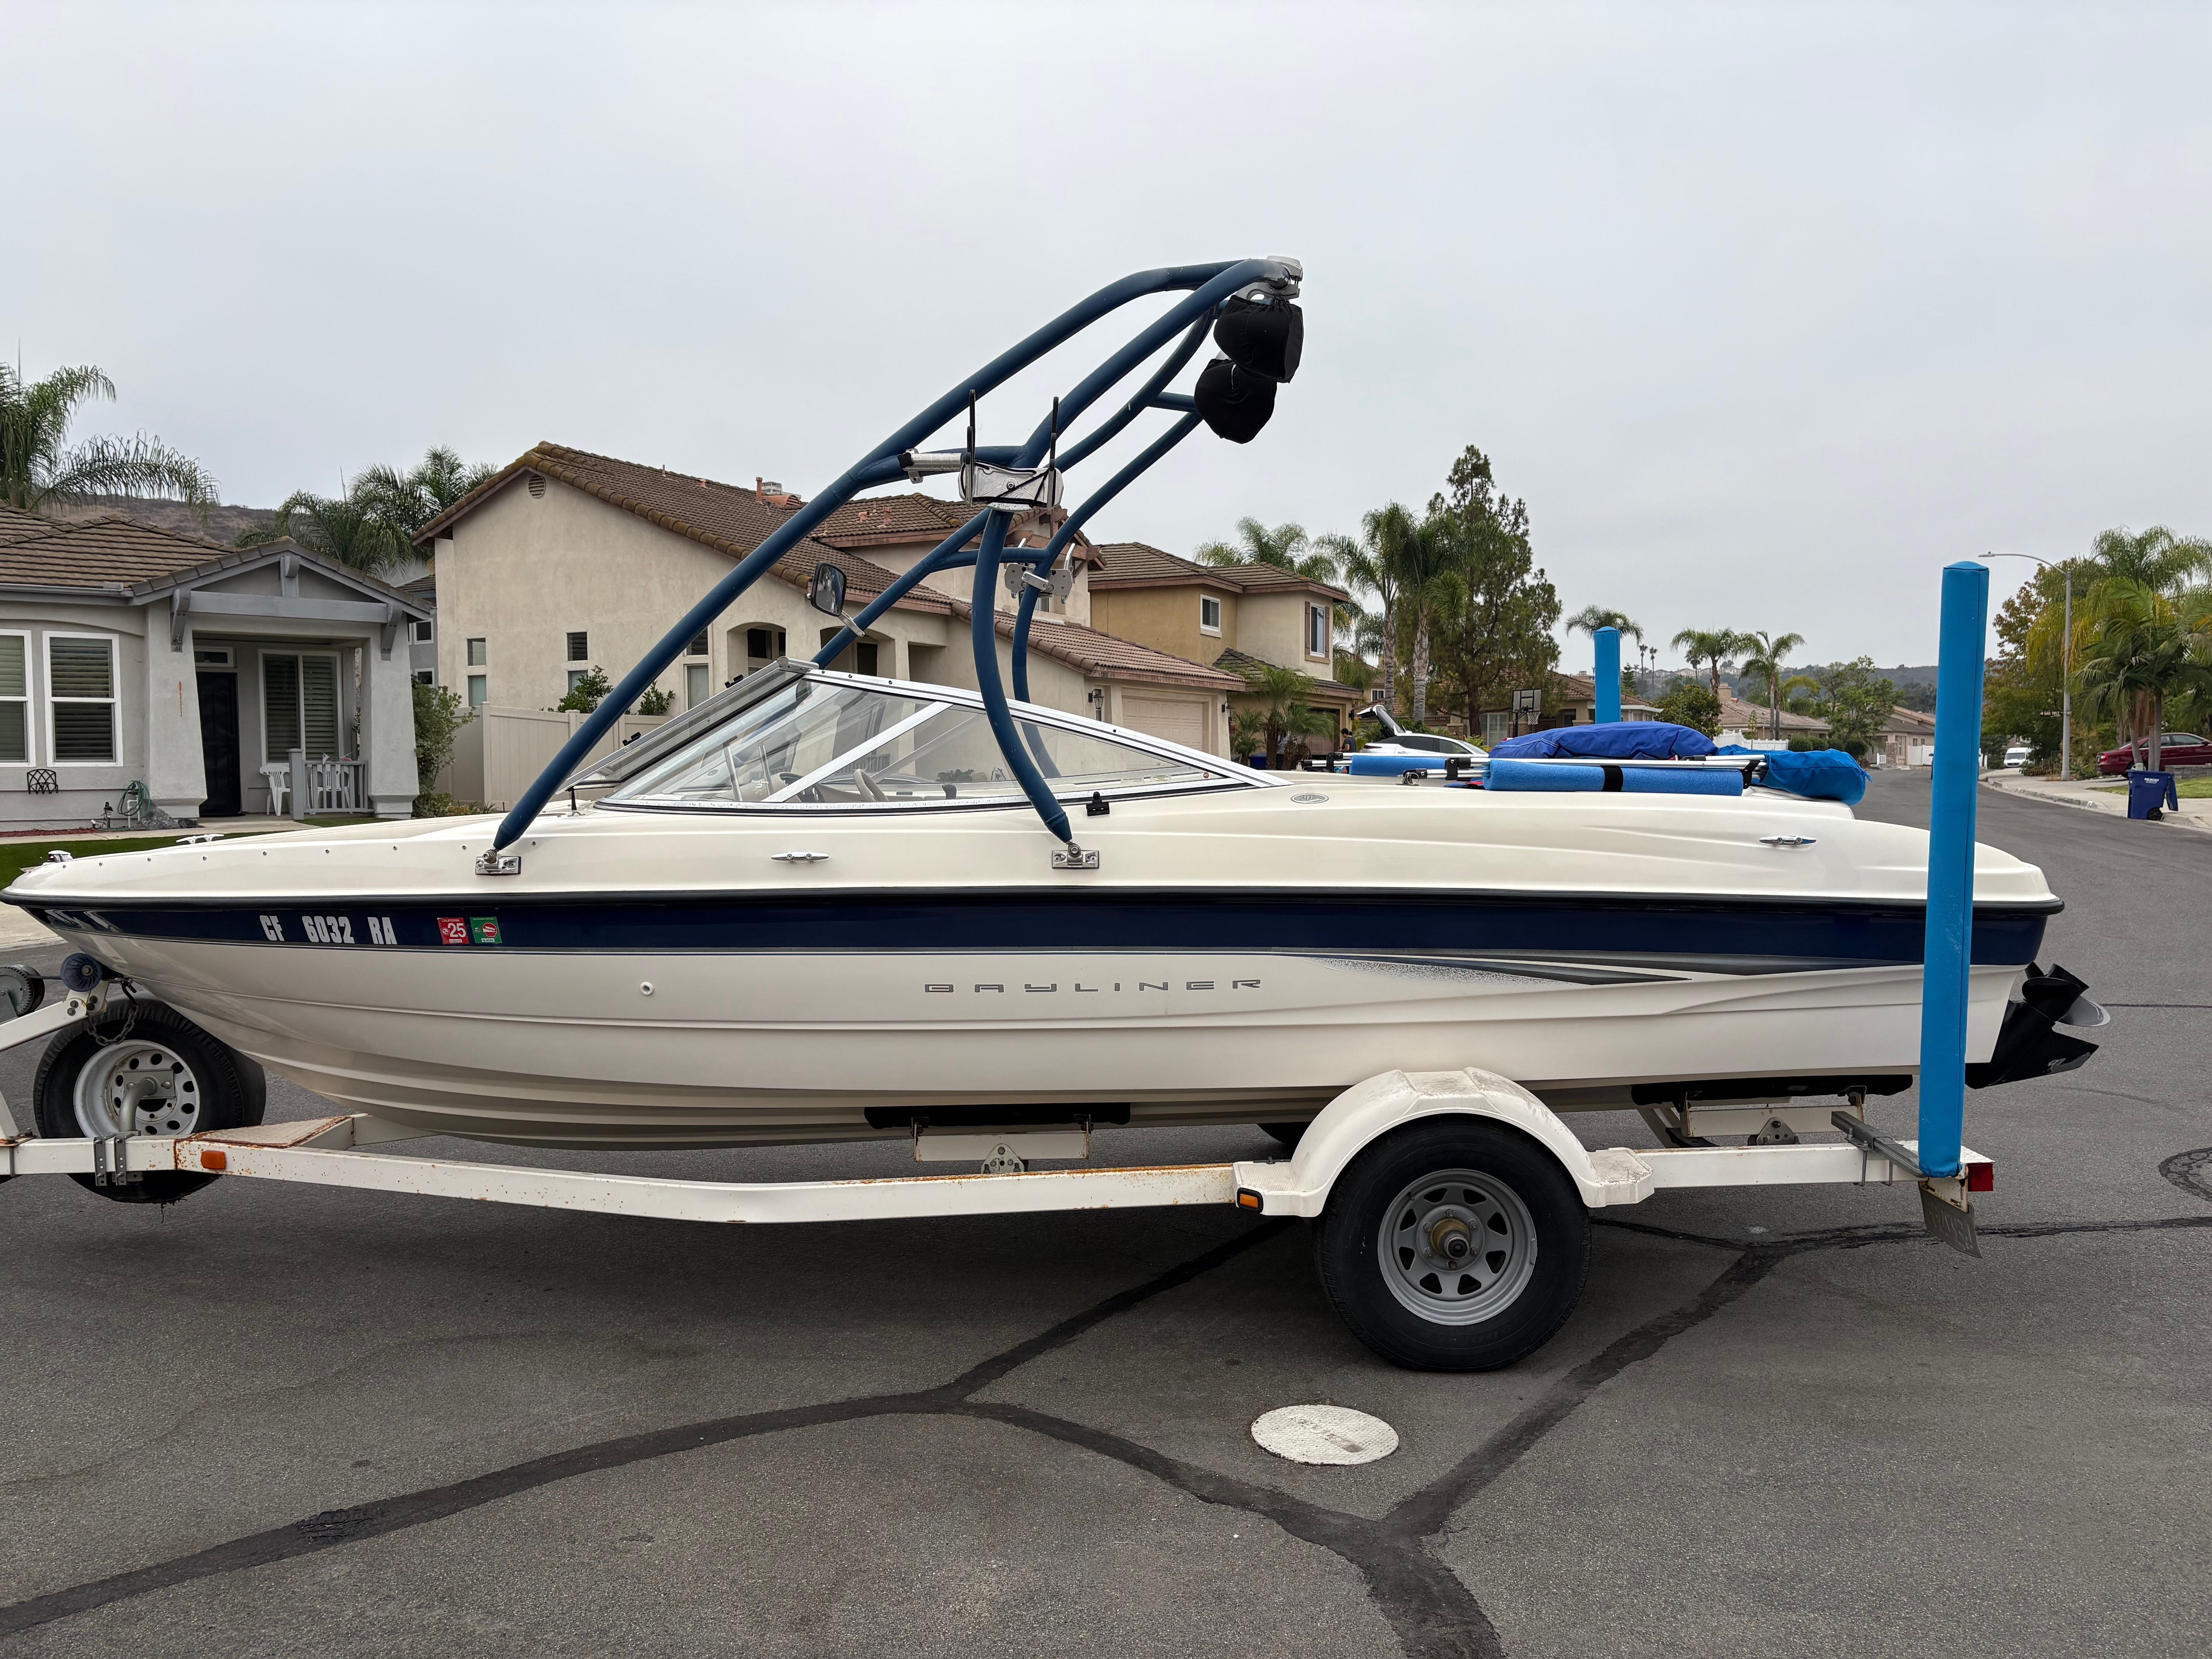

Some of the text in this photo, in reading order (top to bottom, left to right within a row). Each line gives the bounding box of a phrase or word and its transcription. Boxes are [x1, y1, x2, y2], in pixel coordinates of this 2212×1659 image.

[260, 915, 397, 945] CF 6032 RA
[448, 923, 466, 937] 25
[925, 980, 1261, 993] BAYLINER
